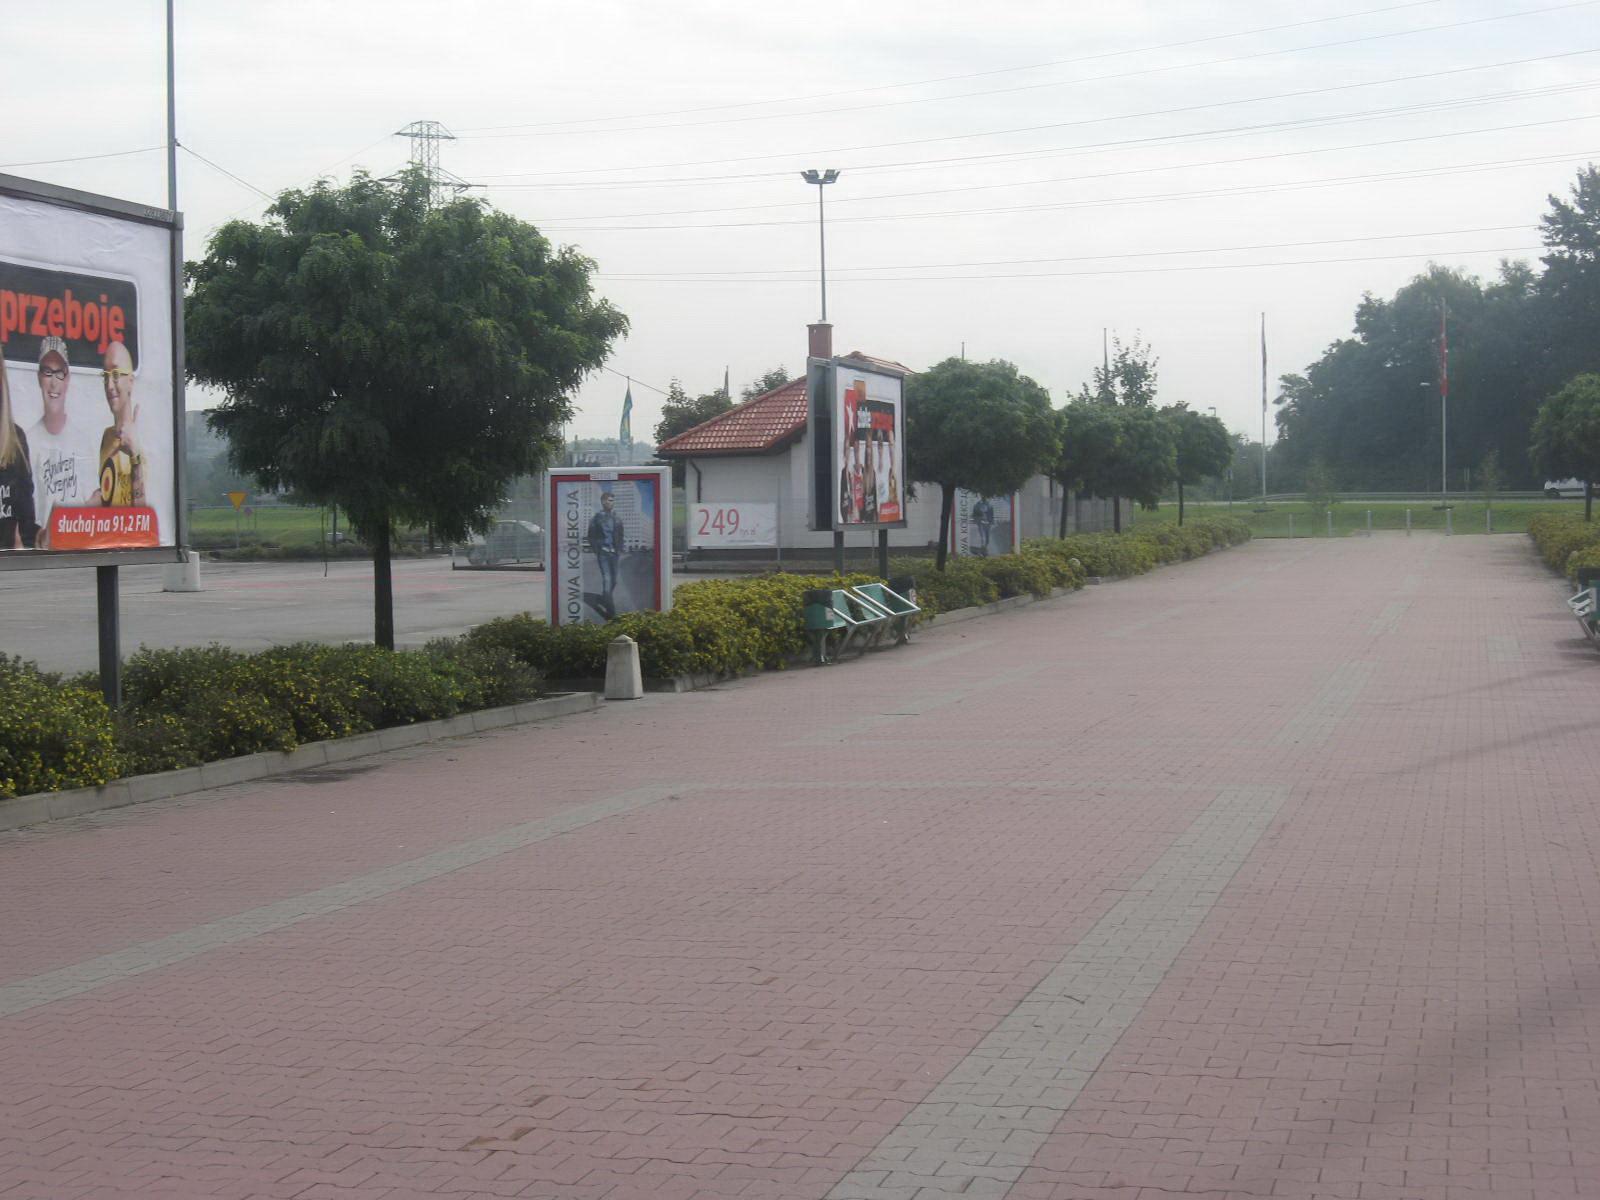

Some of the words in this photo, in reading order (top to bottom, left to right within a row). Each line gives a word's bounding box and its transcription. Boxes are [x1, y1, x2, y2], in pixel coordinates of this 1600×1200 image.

[0, 289, 125, 354] przeboje
[97, 519, 110, 532] na
[112, 515, 134, 533] 91,2
[135, 515, 150, 532] FM
[566, 490, 580, 569] KOLEKCJA
[698, 508, 740, 535] 249
